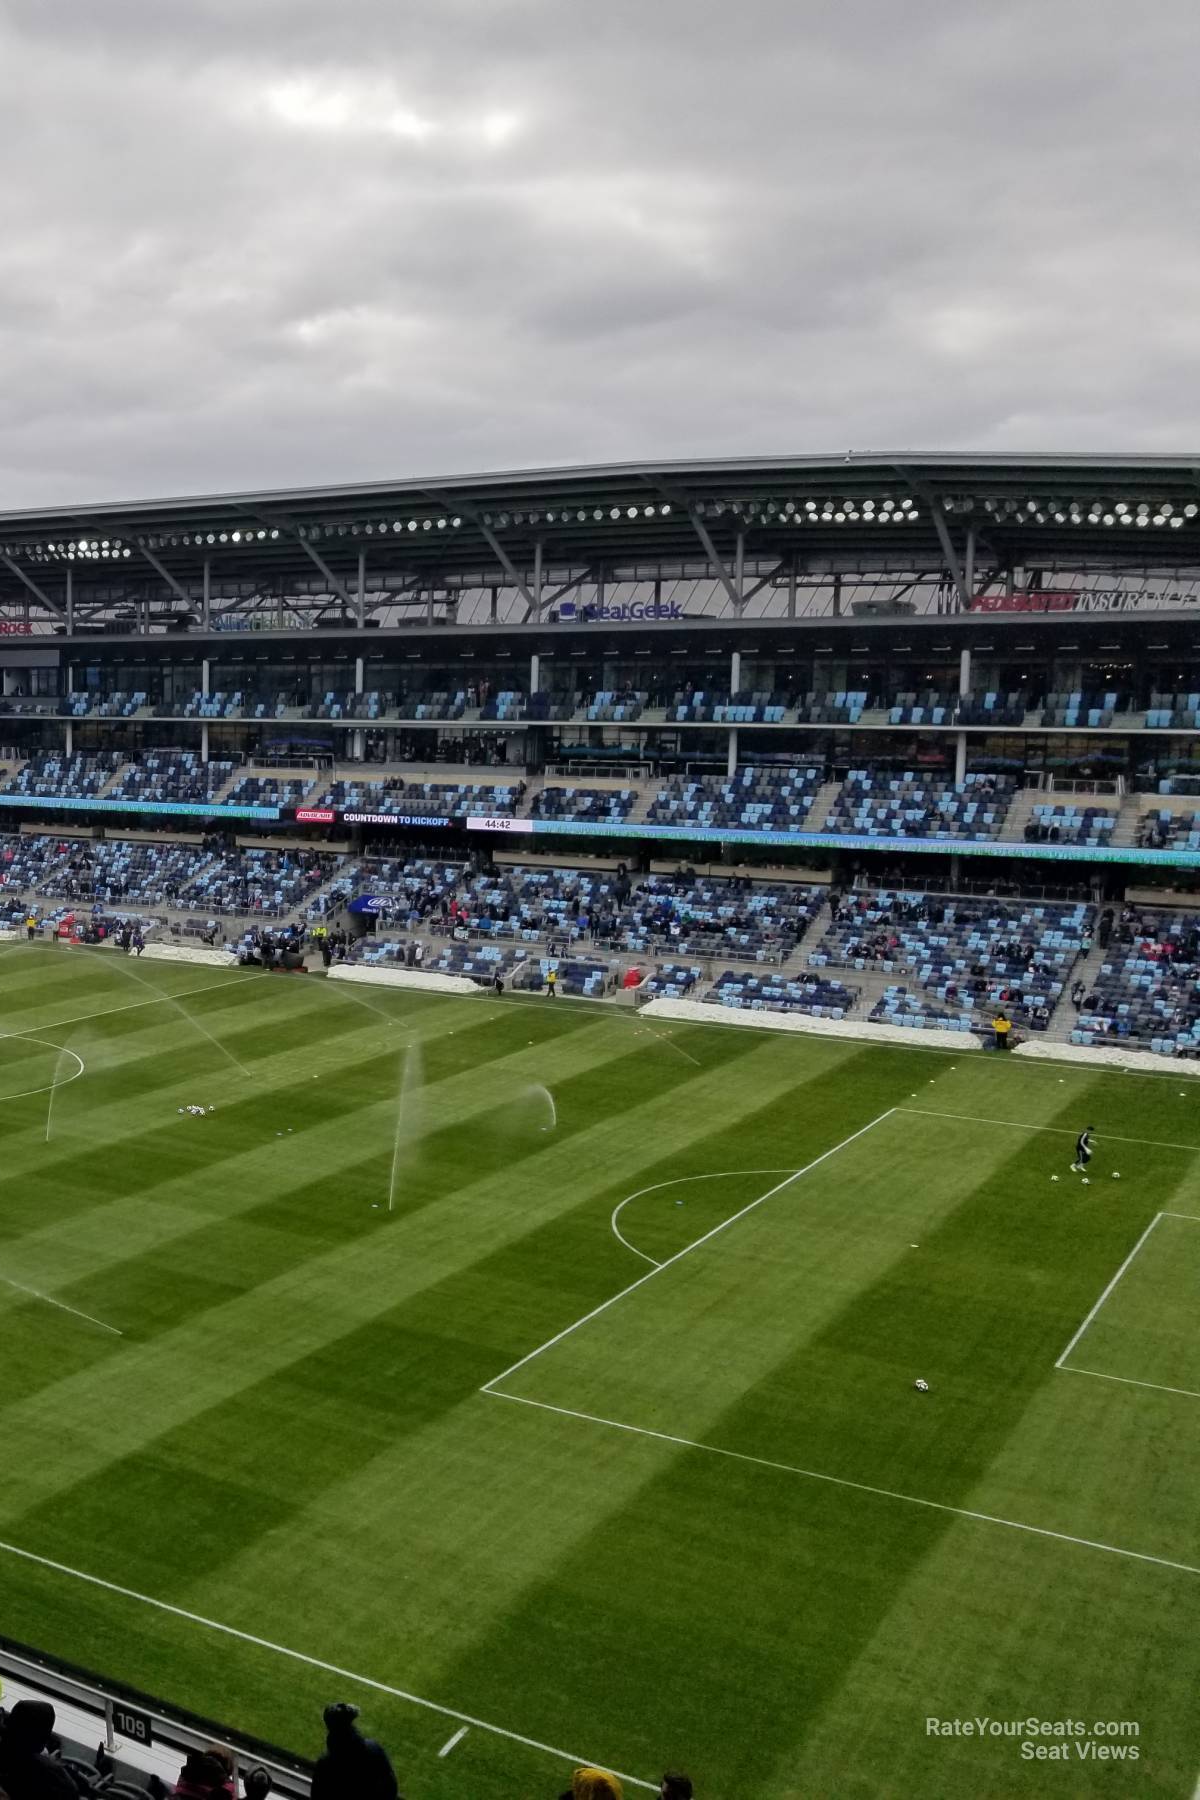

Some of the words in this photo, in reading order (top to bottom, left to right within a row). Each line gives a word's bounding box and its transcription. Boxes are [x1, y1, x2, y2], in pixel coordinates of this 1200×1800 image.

[585, 600, 682, 620] SeatGeek
[343, 812, 398, 825] COUNTDOWN
[399, 815, 411, 825] TO
[484, 819, 511, 830] 44:42
[116, 1711, 146, 1739] 109
